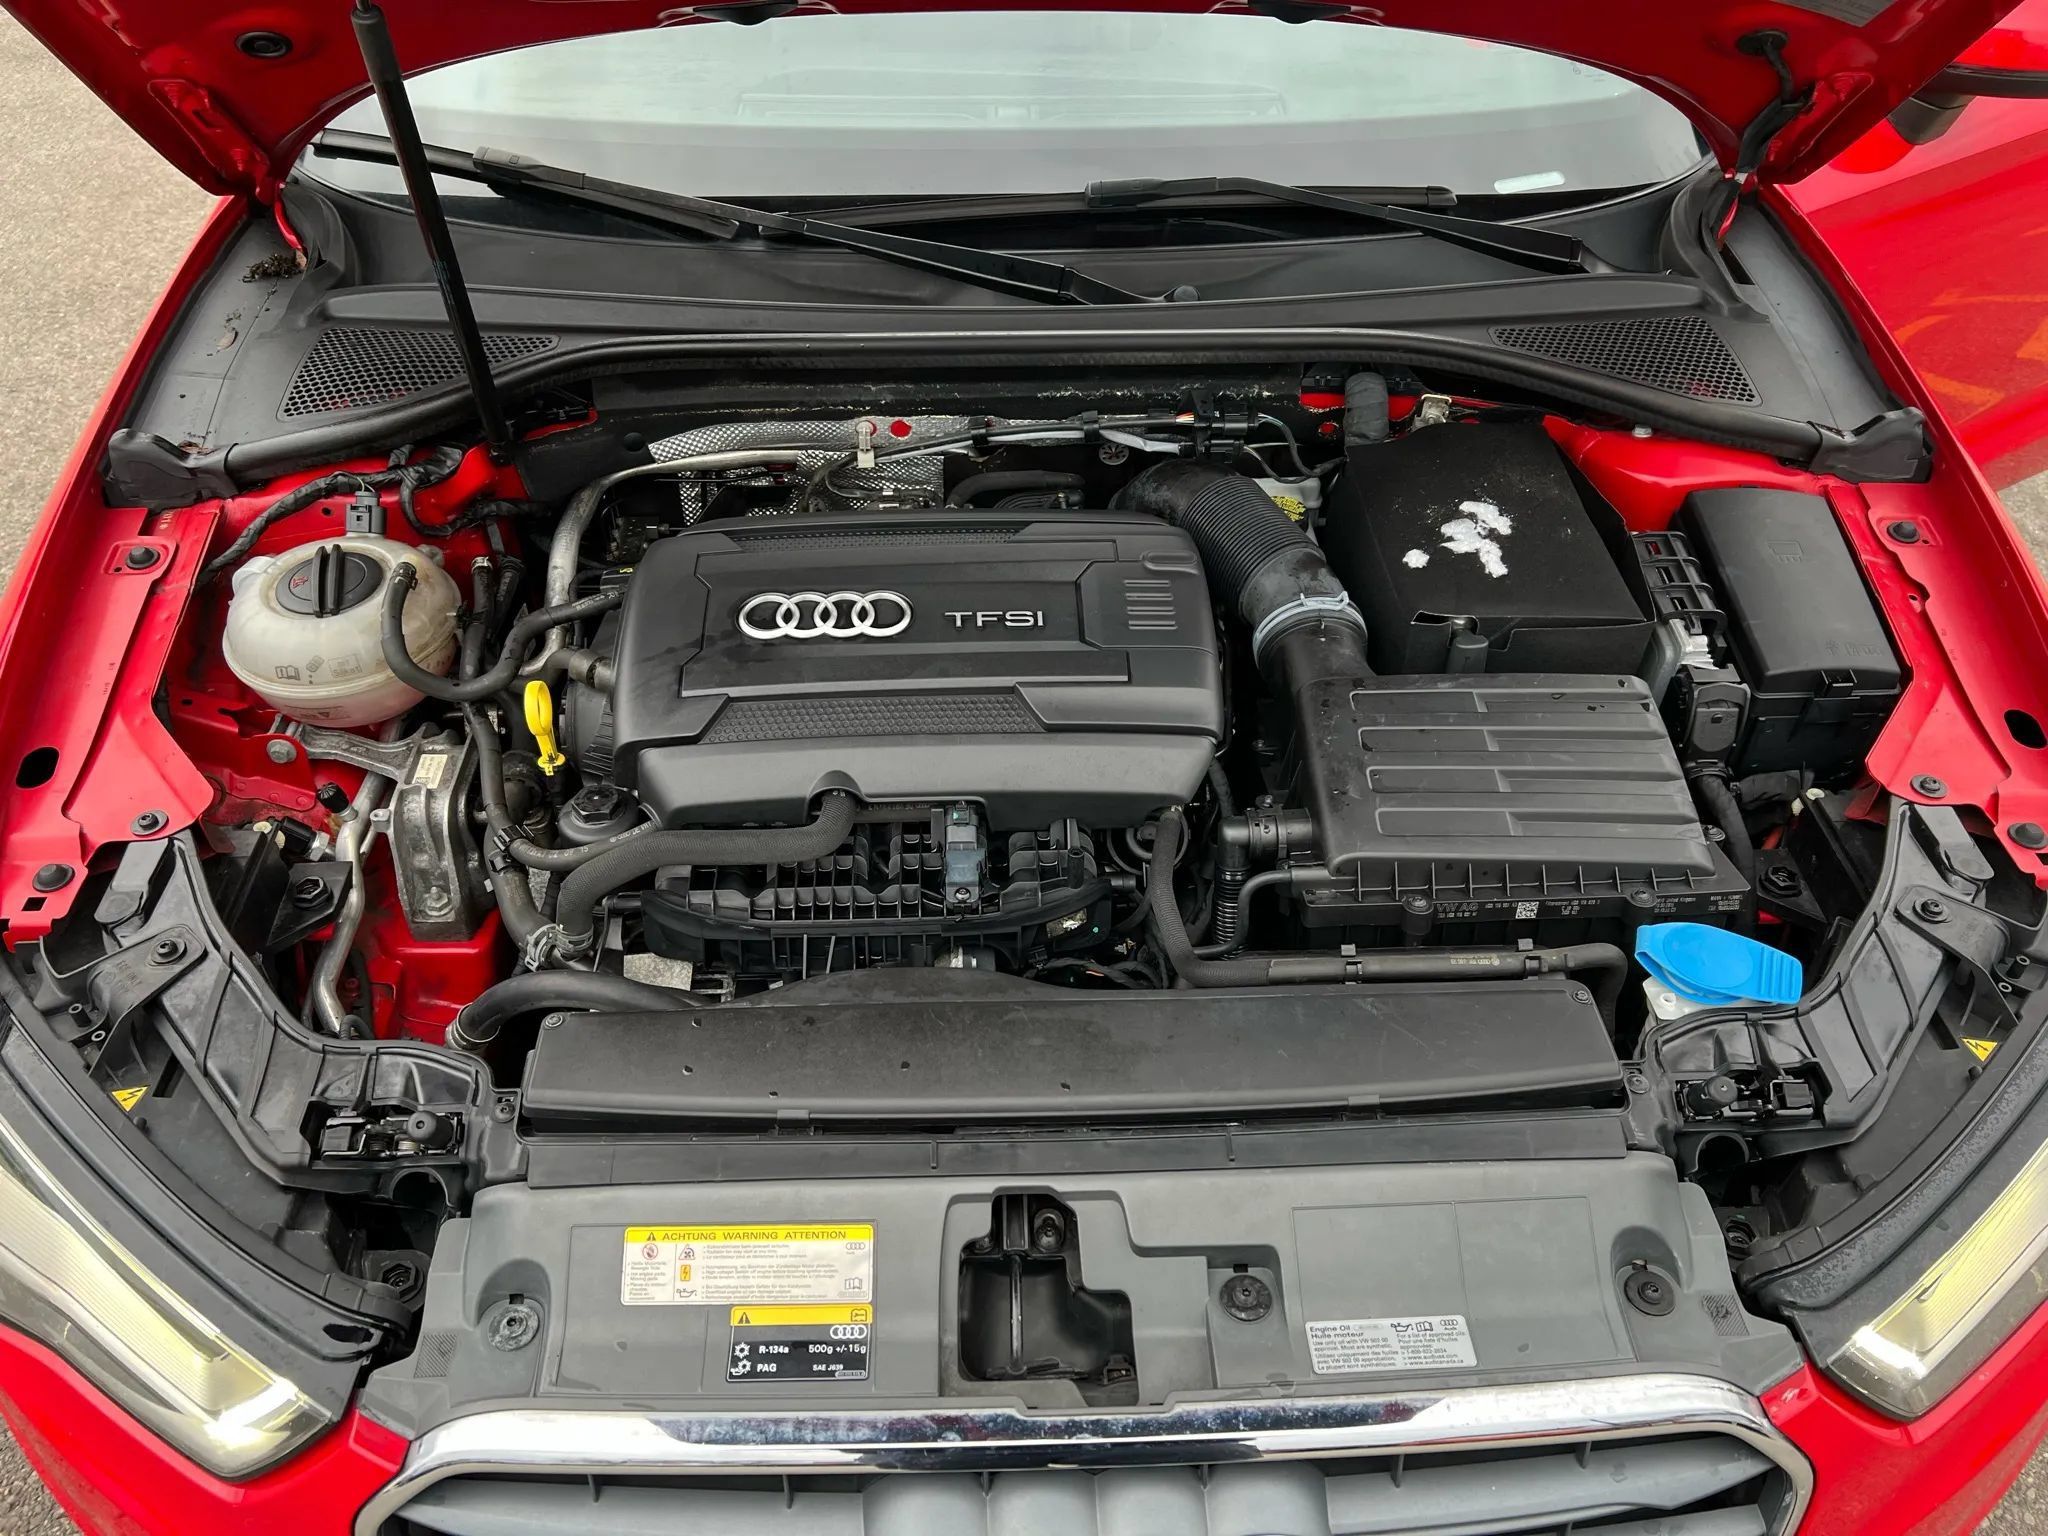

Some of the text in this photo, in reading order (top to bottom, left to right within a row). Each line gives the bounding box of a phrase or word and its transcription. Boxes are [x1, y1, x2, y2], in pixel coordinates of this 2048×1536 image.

[945, 610, 1045, 629] TFSI
[1459, 902, 1479, 911] AG
[662, 1230, 847, 1241] ACHTUNG WARNING ATTENTION
[1310, 1326, 1338, 1335] Engine
[759, 1345, 790, 1354] R-134a
[808, 1344, 833, 1355] 500g
[848, 1344, 867, 1355] 15g
[757, 1363, 777, 1373] PAG
[827, 1363, 844, 1371] J639
